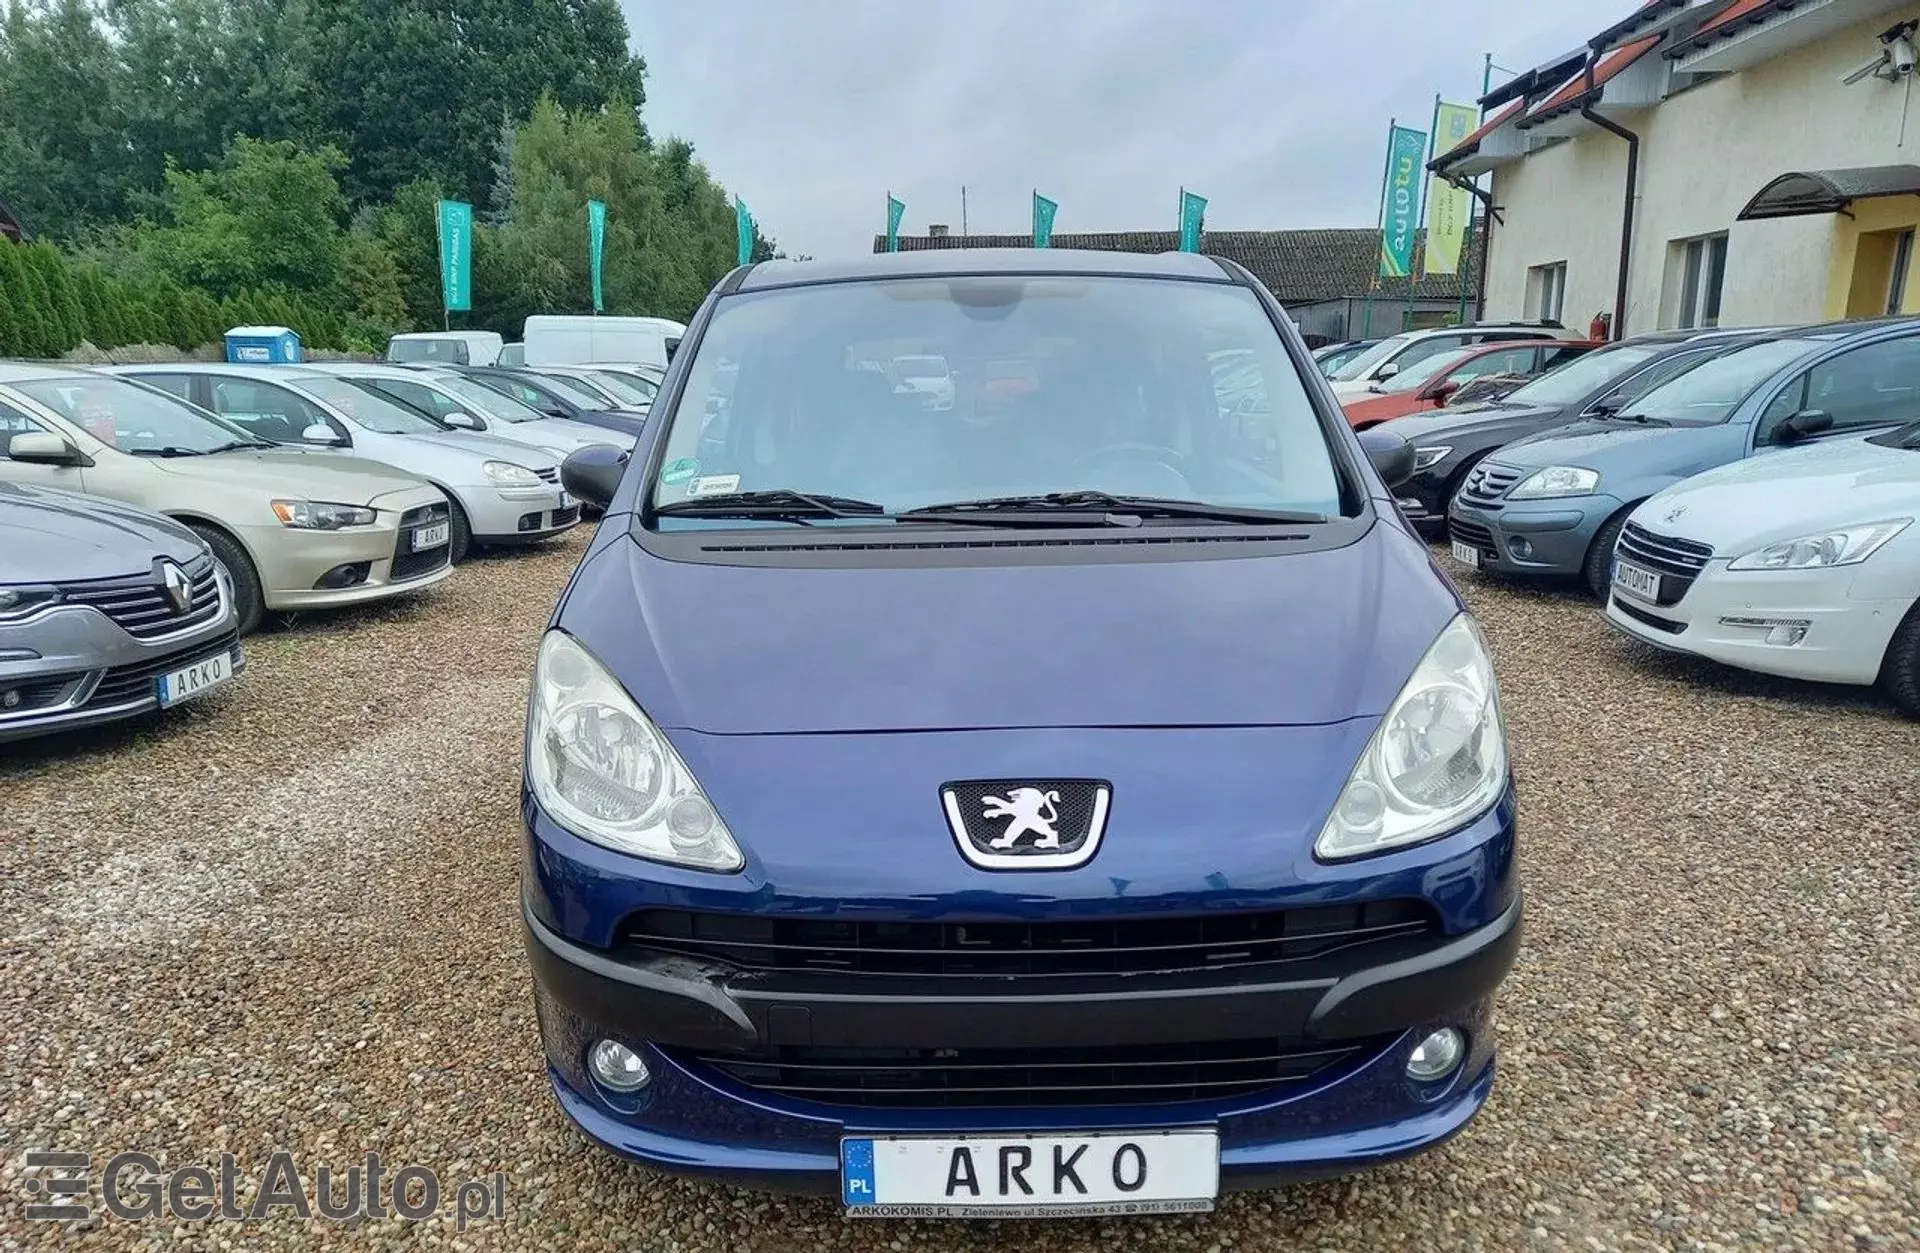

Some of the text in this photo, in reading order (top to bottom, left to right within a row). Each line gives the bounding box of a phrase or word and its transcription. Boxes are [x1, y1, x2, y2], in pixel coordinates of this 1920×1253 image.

[1618, 564, 1655, 595] AUTOMAT
[178, 659, 220, 694] ARKO
[945, 1142, 1147, 1196] ARKO
[850, 1179, 871, 1193] PL
[852, 1206, 953, 1216] ARKOKOMIS.PL
[962, 1207, 1020, 1216] Zieleniewo
[1108, 1204, 1121, 1213] 43
